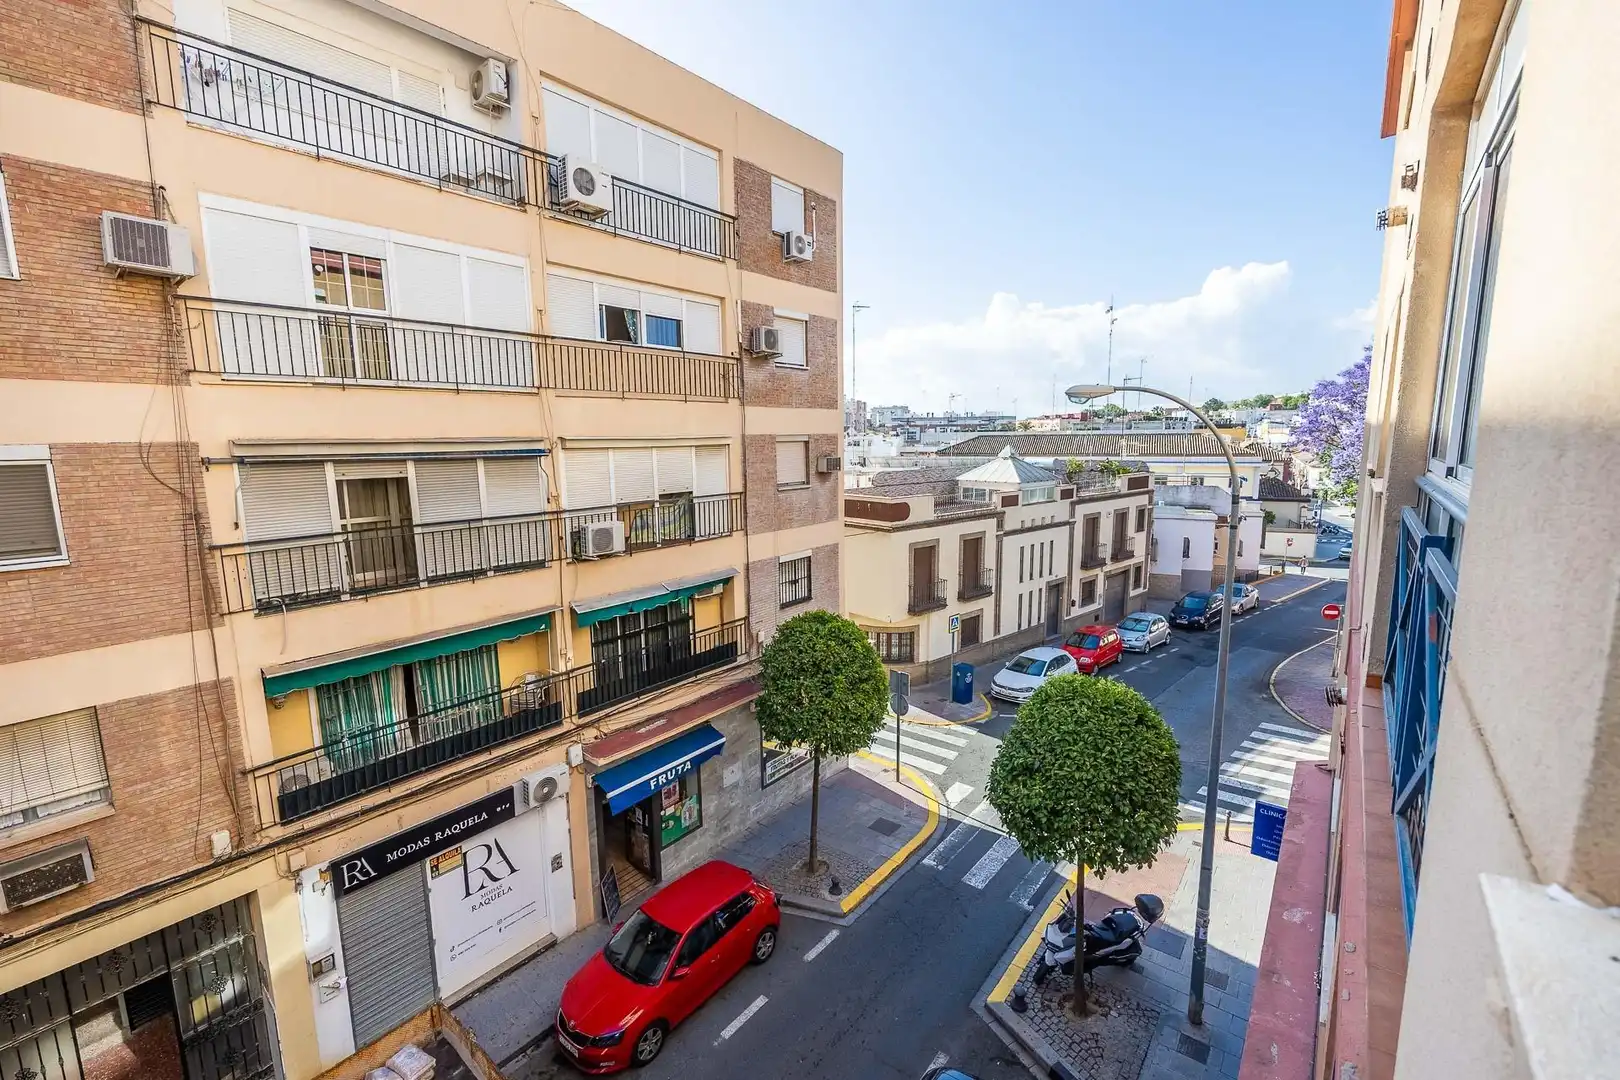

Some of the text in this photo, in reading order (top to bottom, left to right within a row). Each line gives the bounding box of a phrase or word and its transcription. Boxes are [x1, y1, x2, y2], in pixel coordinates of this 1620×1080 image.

[650, 761, 691, 790] FRUTA
[386, 811, 488, 863] MODAS RAQUELA
[438, 847, 462, 863] ALQUILA
[471, 886, 513, 912] RAQUELA
[480, 883, 503, 900] MODAS
